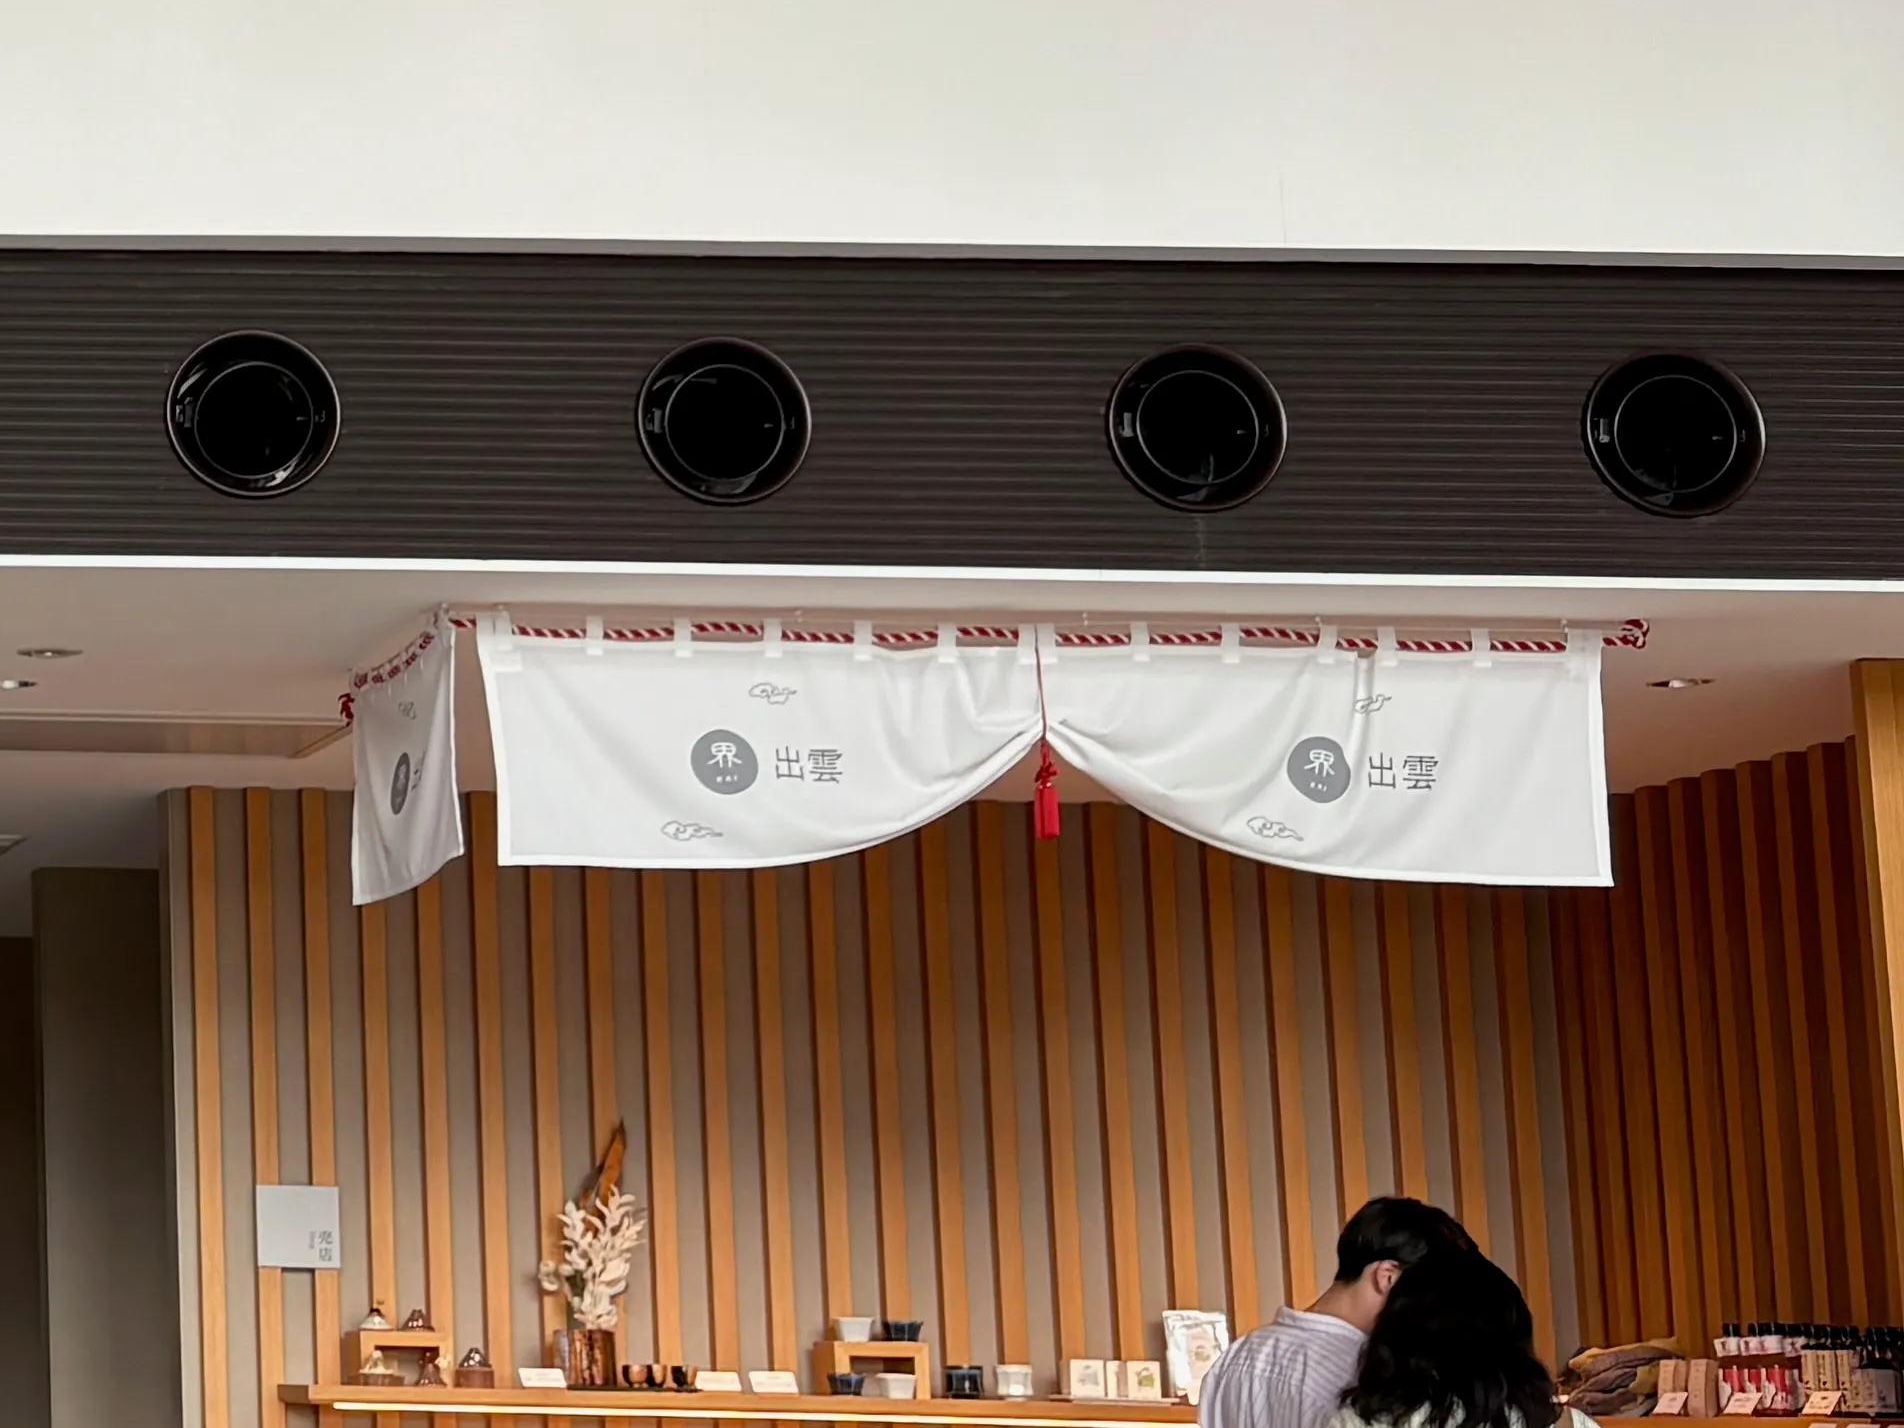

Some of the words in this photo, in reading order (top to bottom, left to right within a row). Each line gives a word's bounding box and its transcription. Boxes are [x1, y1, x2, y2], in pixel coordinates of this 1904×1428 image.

[707, 742, 743, 769] 界
[775, 746, 844, 784] 出雲
[1304, 749, 1335, 778] 界
[1367, 752, 1439, 791] 出雲
